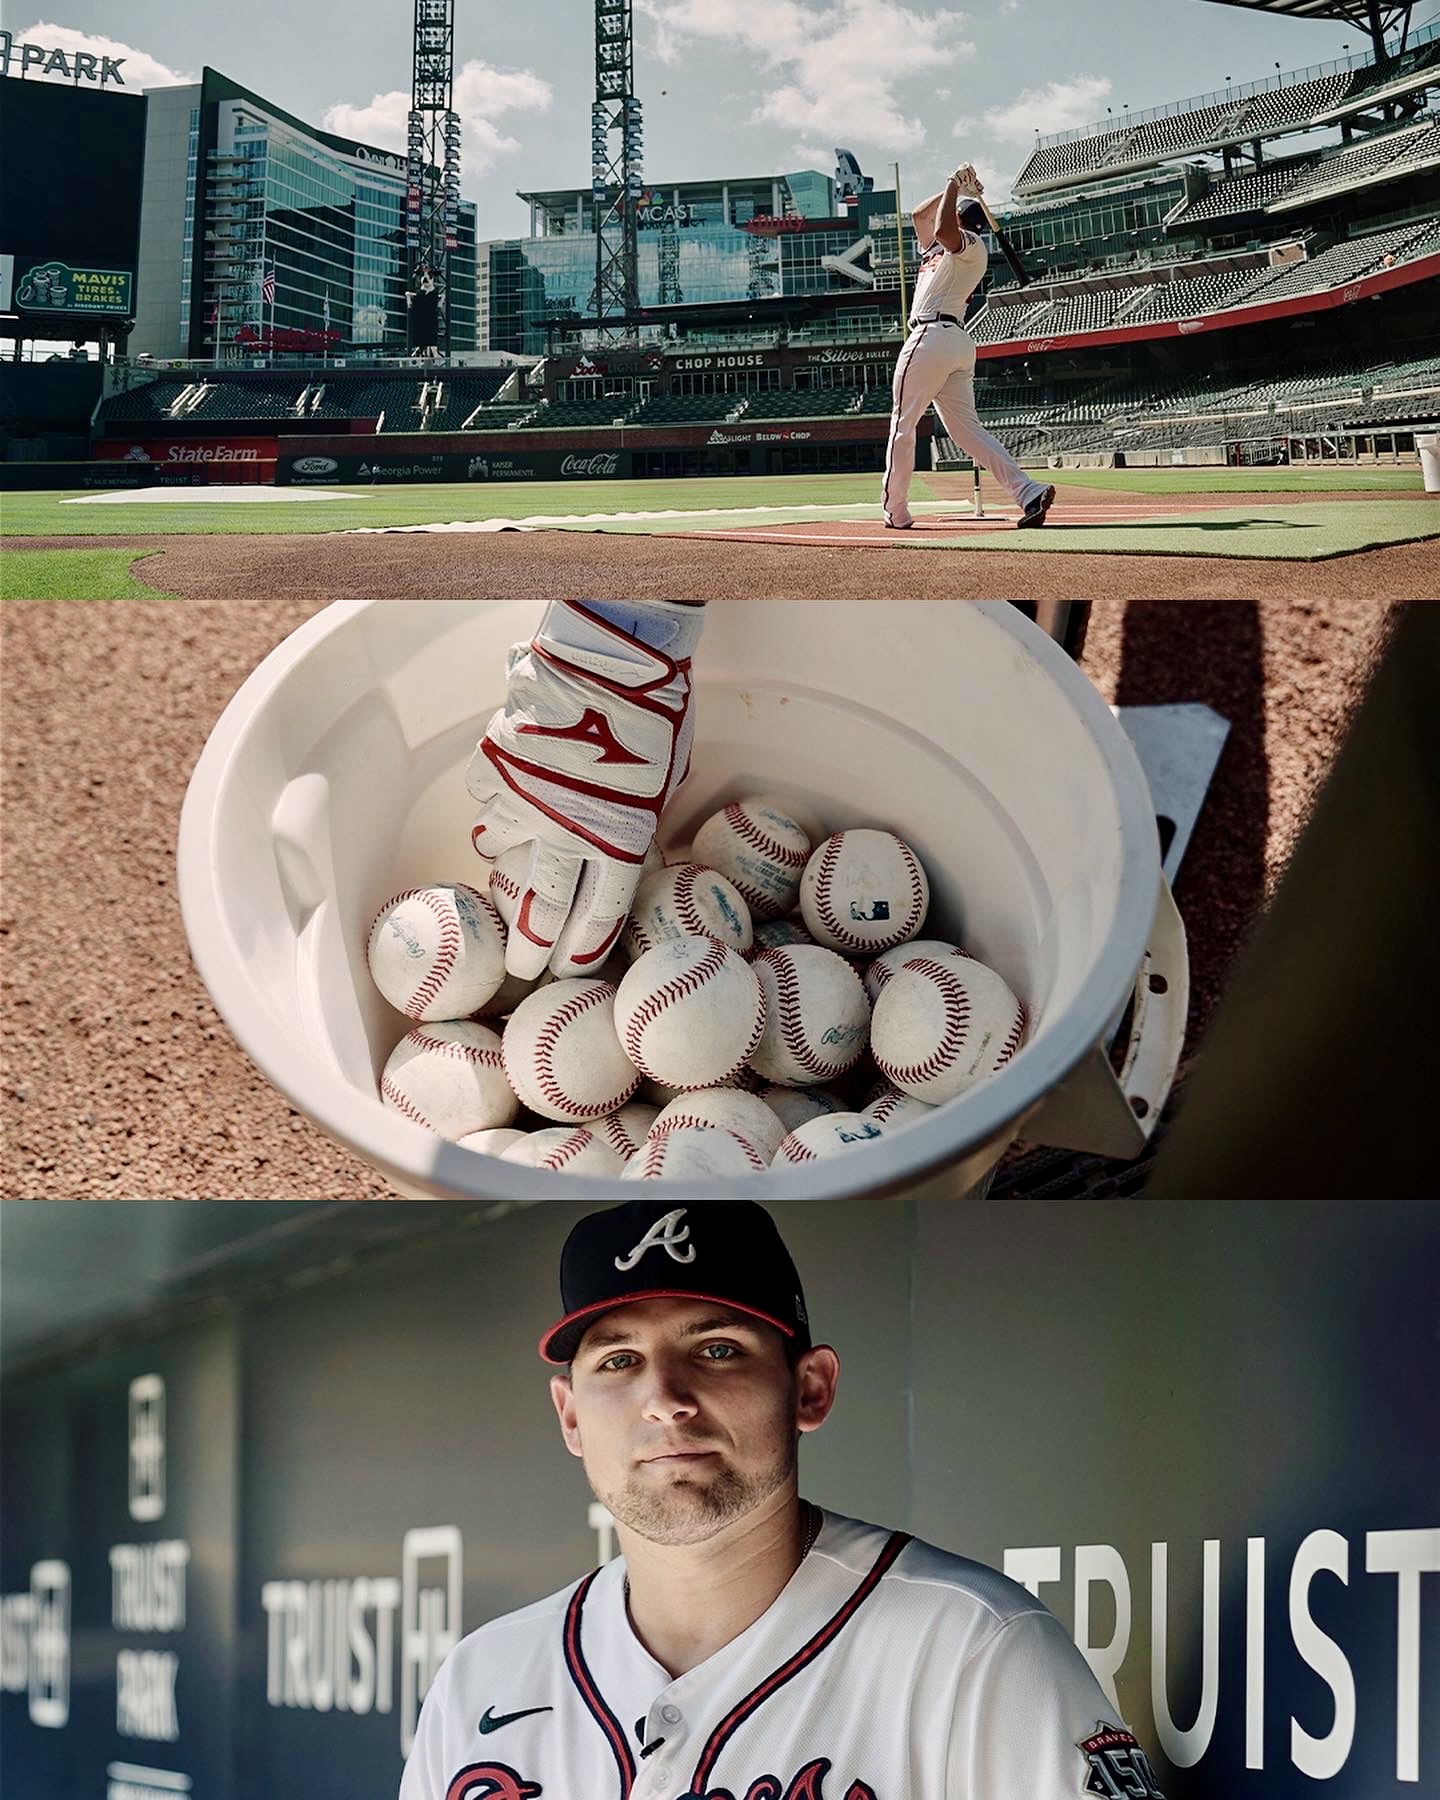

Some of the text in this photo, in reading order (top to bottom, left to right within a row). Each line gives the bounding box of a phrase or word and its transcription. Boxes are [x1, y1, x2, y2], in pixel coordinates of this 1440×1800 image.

[22, 43, 126, 85] PARK
[72, 273, 126, 286] MAVIS
[75, 294, 123, 303] BRAKES
[675, 354, 763, 369] CHOP HOUSE
[820, 349, 865, 363] Silver
[755, 432, 782, 442] BELOW
[790, 431, 811, 440] CHOP
[301, 460, 329, 471] Ford
[413, 465, 443, 475] Power
[614, 1207, 697, 1271] A
[261, 1577, 399, 1715] TRUIST
[1088, 1732, 1134, 1749] BRAVES
